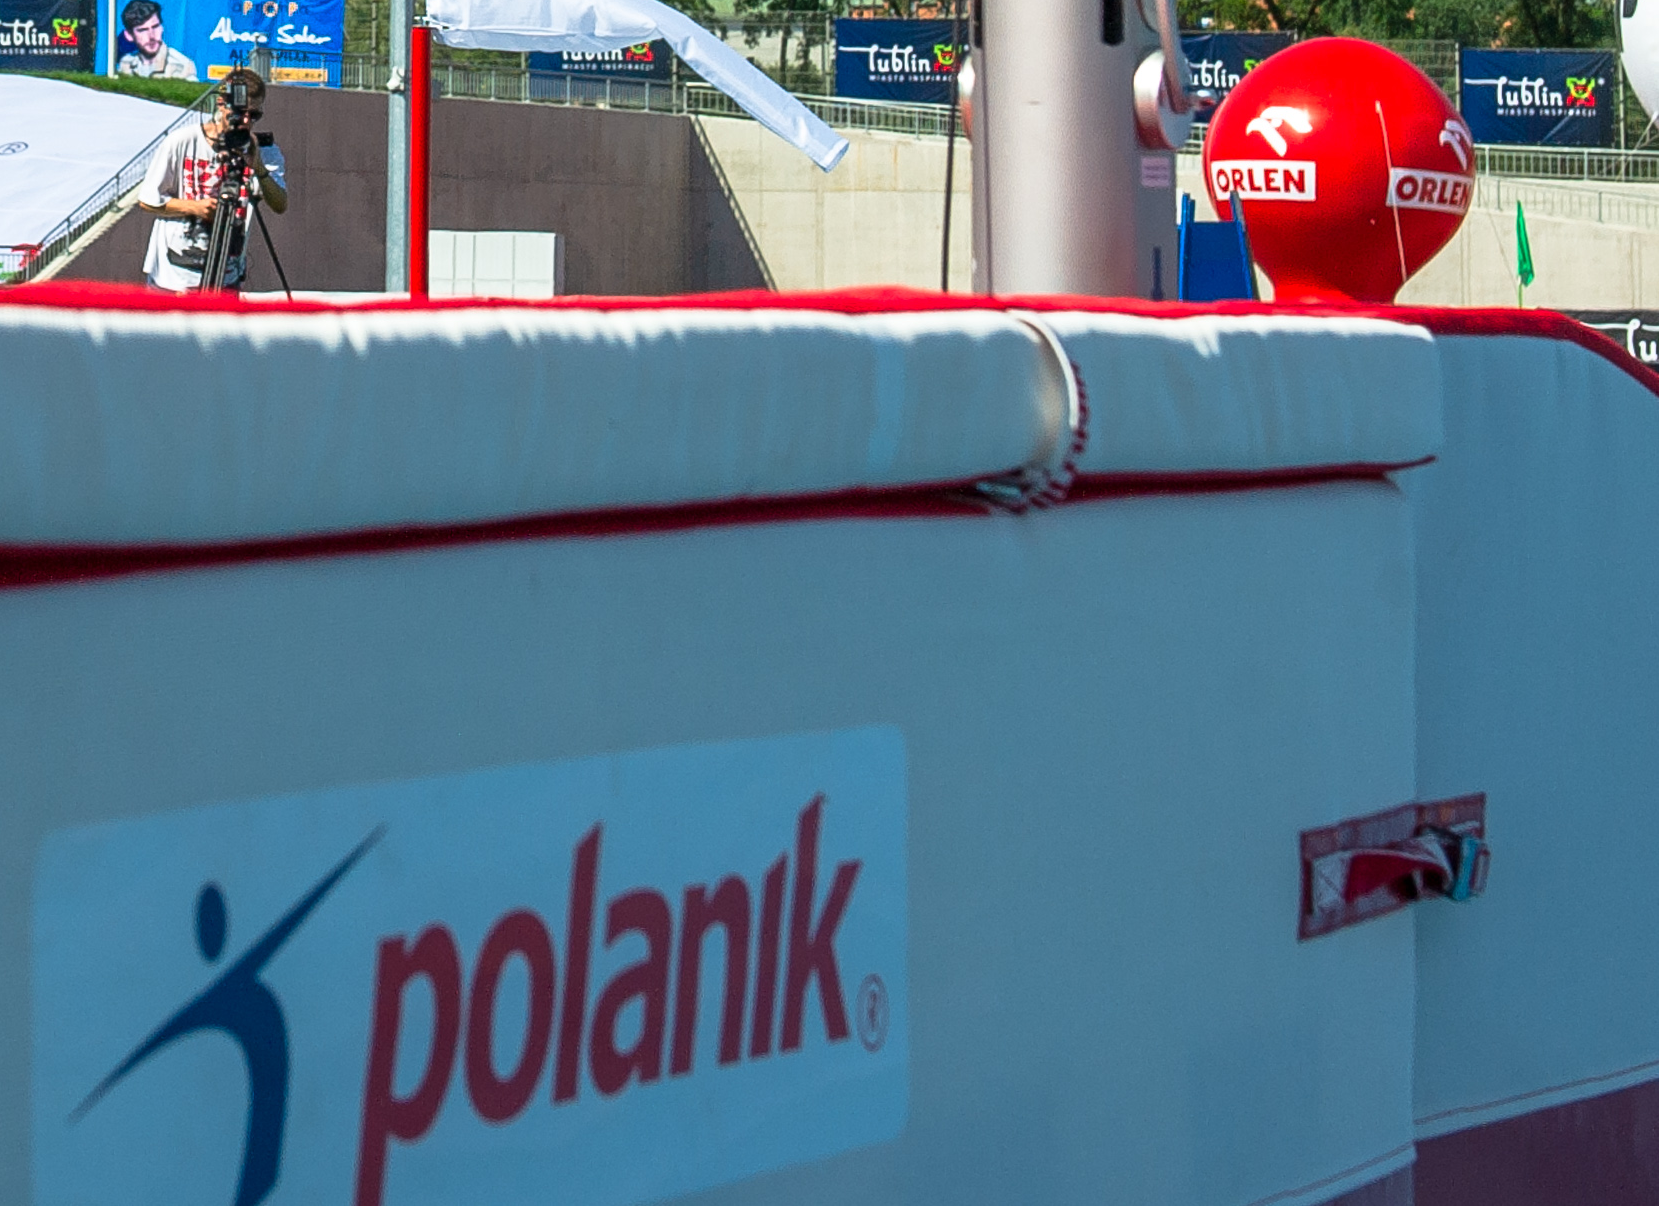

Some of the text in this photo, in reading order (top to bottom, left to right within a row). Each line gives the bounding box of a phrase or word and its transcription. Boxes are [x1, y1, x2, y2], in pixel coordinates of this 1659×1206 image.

[839, 44, 931, 73] lublin
[1185, 58, 1241, 88] ublin
[1464, 76, 1563, 106] lublin
[1215, 168, 1306, 194] ORLEN
[1395, 174, 1470, 207] ORLEN
[354, 792, 862, 1206] polanik
